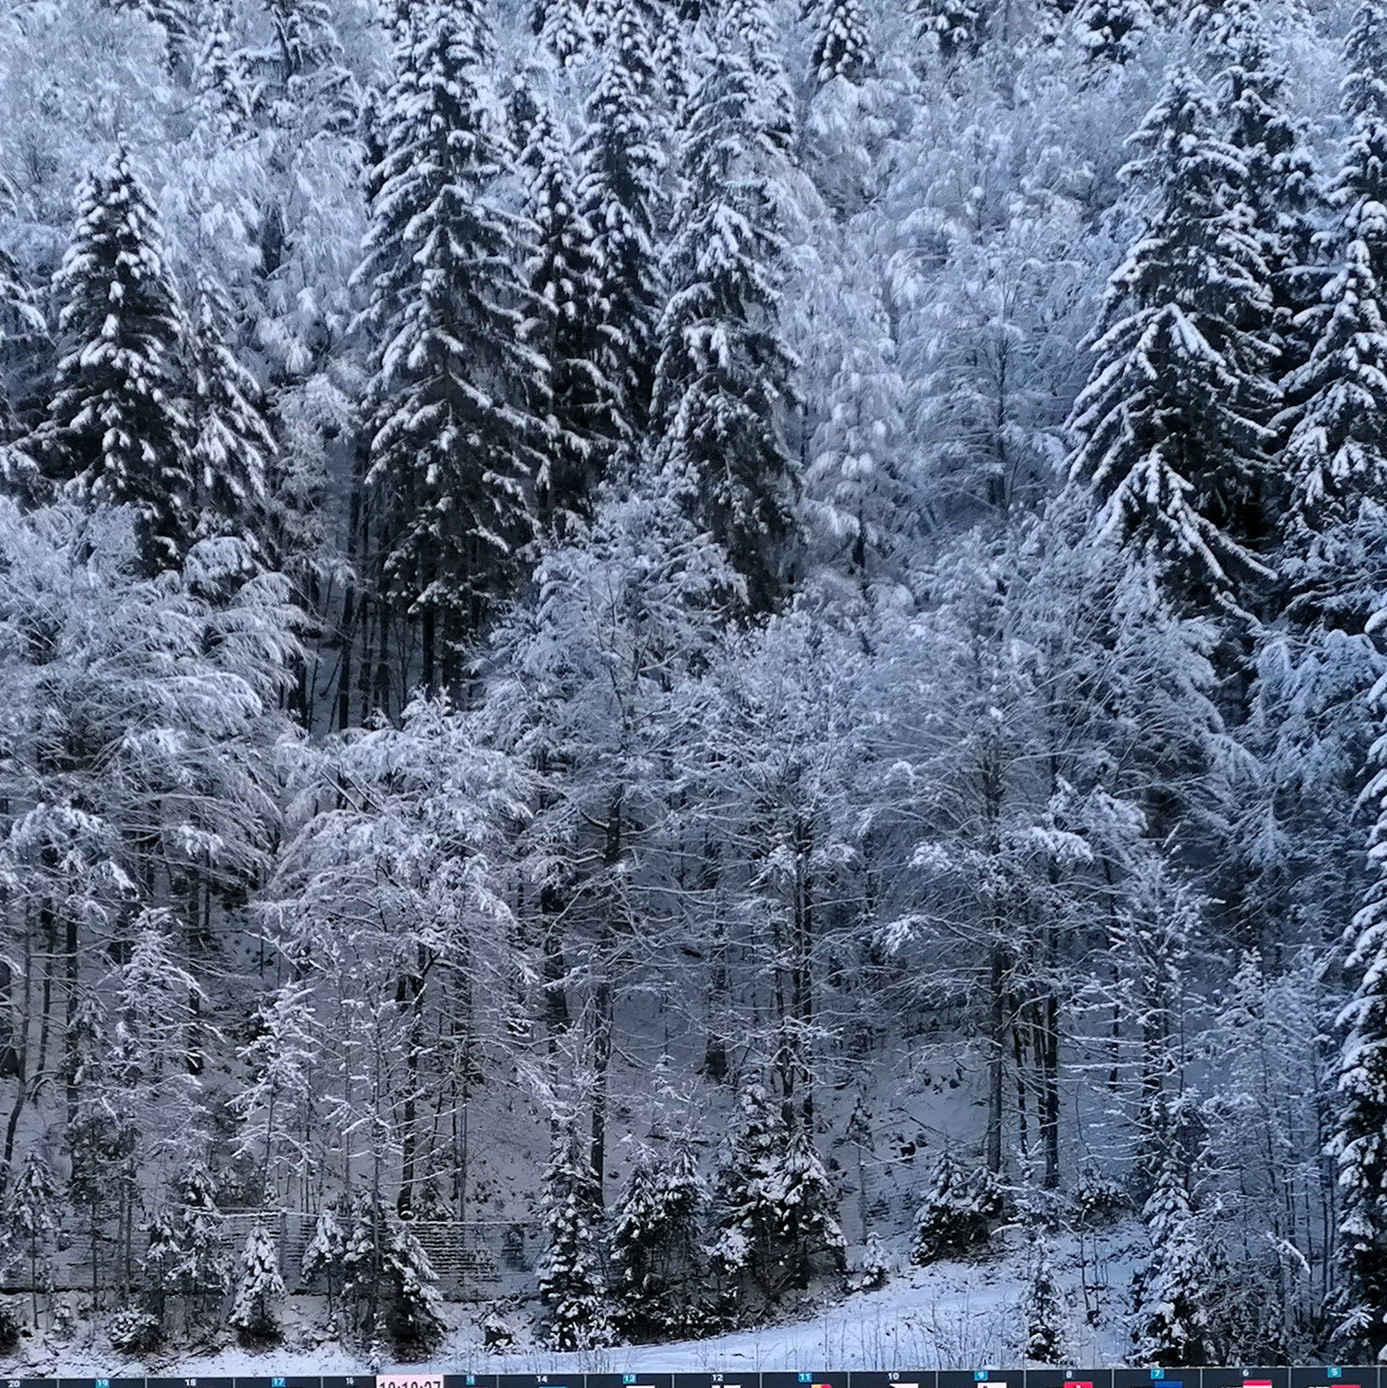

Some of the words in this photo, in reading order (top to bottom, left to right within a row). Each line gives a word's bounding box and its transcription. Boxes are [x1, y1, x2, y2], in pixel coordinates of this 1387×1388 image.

[536, 1375, 547, 1383] 14
[800, 1373, 811, 1381] 11
[977, 1371, 984, 1379] 9
[273, 1378, 285, 1386] 17
